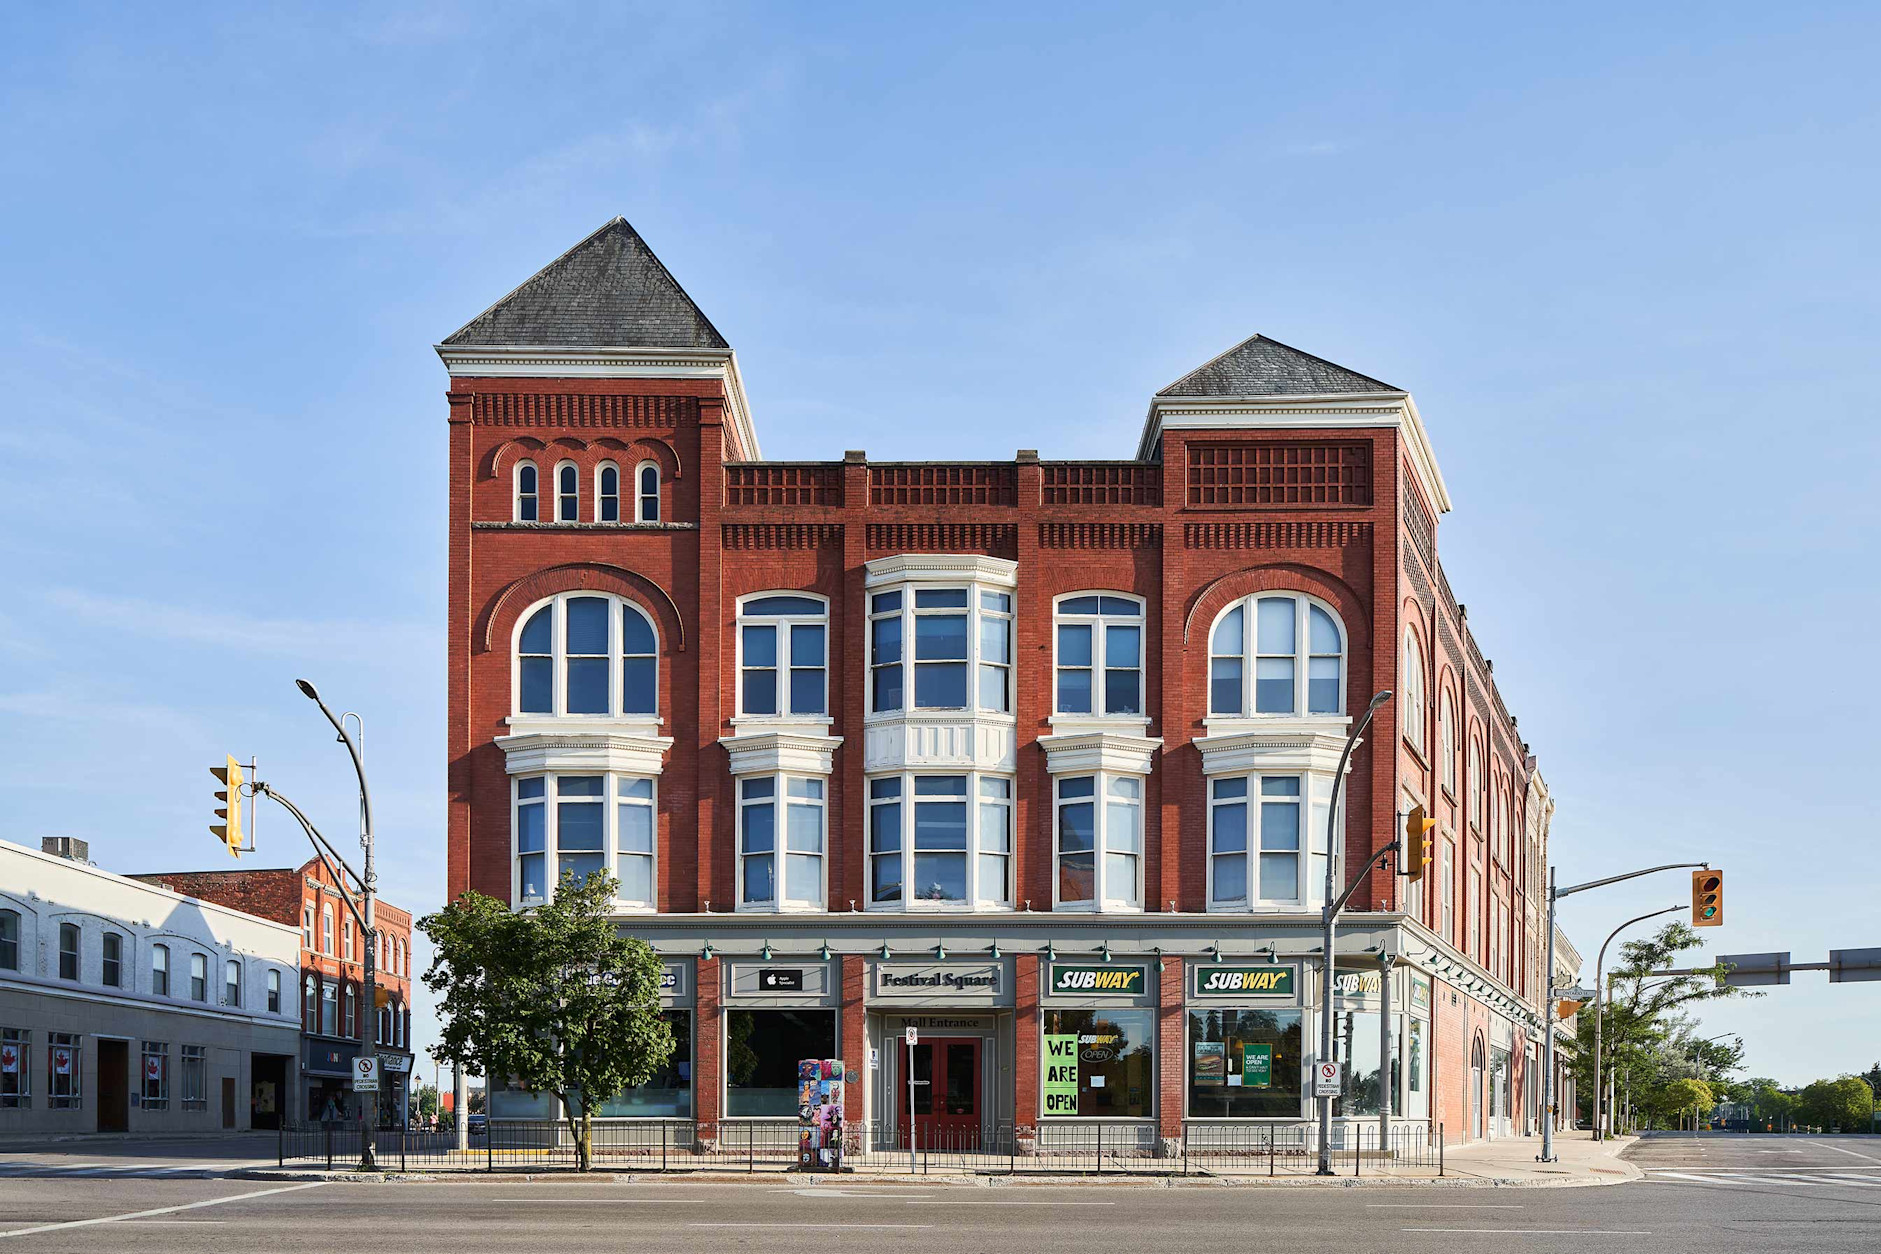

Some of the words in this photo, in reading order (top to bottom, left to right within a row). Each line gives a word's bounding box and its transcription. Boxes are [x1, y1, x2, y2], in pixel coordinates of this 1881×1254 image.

[880, 971, 941, 987] Festival
[942, 972, 998, 991] Square
[1057, 971, 1140, 989] SUBWAY
[1204, 971, 1287, 990] SUBWAY
[901, 1017, 926, 1028] Mall
[929, 1017, 979, 1028] Entrance
[1078, 1034, 1119, 1044] SUBWAY
[1048, 1040, 1074, 1056] WE
[1084, 1049, 1110, 1059] OPEN
[1048, 1065, 1077, 1082] ARE
[1047, 1094, 1077, 1111] OPEN
